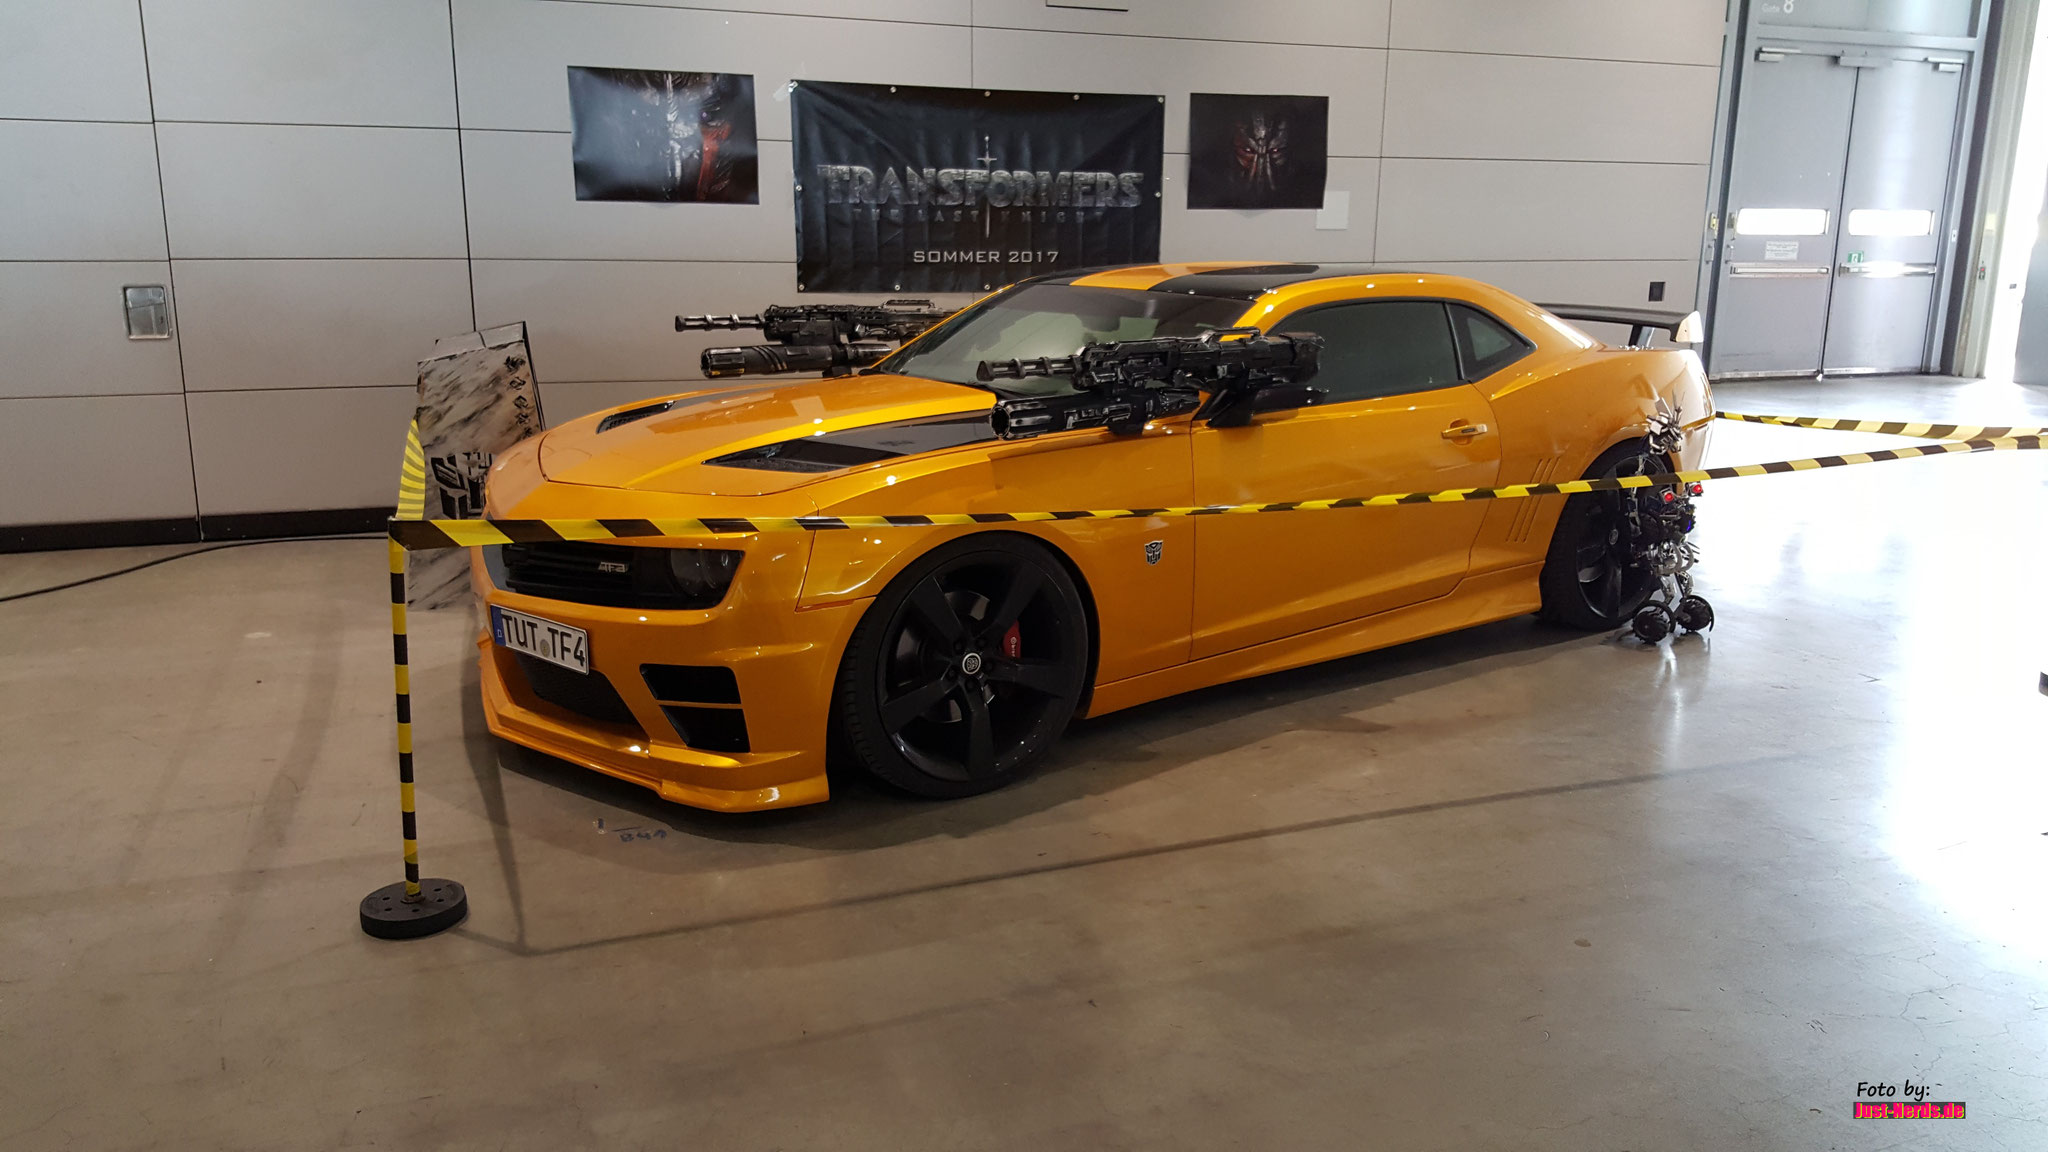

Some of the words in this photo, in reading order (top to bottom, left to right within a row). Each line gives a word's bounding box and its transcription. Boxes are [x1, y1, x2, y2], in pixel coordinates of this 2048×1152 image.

[1783, 0, 1795, 14] 8
[817, 164, 1144, 207] TRANSFORMERS
[917, 209, 980, 223] LAST
[912, 250, 1000, 263] SOMMER
[1008, 251, 1059, 263] 2017
[501, 614, 538, 651] TUT
[547, 627, 586, 667] TF4
